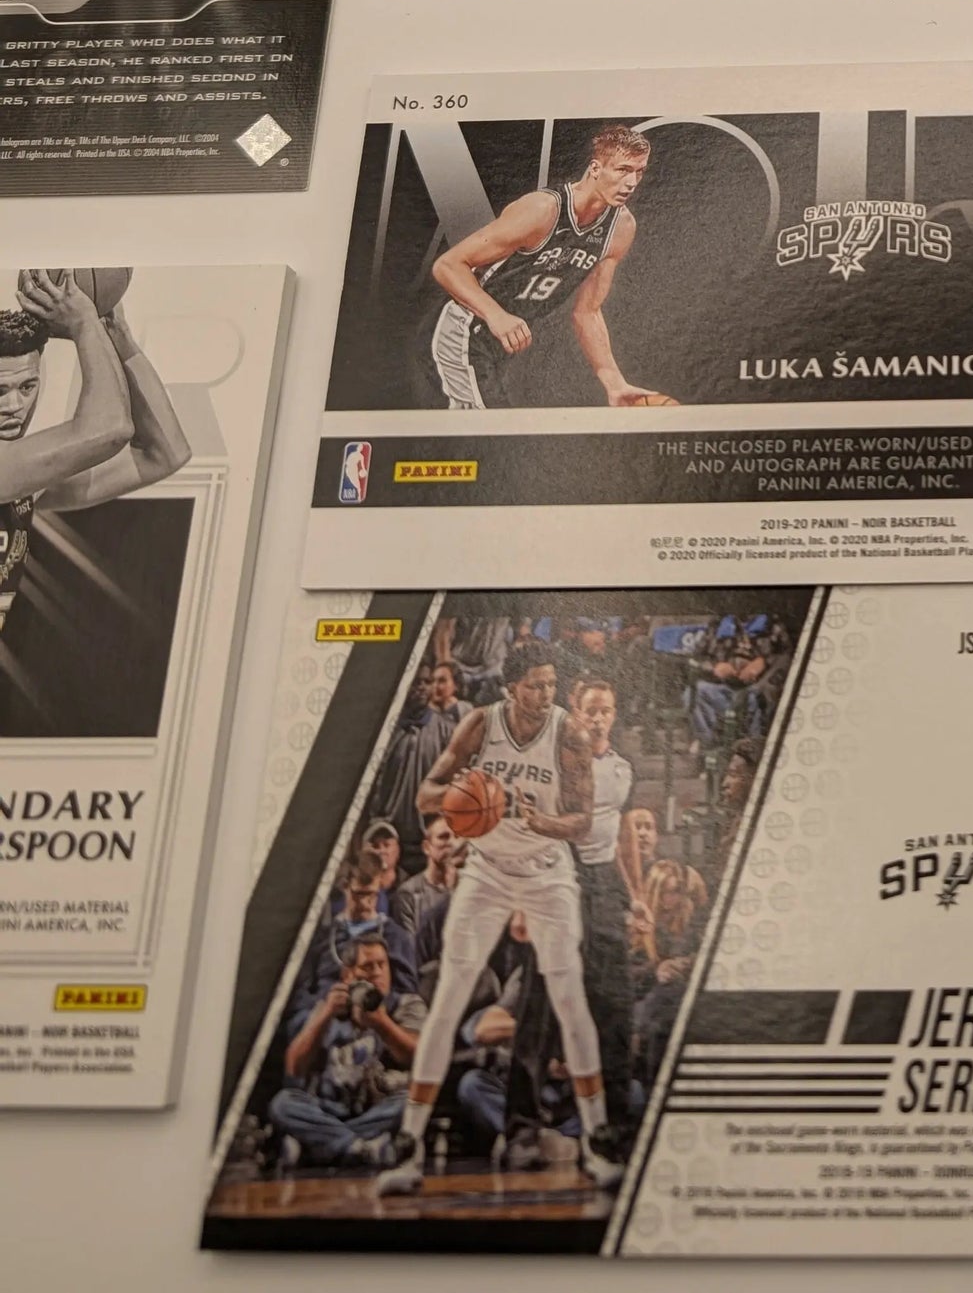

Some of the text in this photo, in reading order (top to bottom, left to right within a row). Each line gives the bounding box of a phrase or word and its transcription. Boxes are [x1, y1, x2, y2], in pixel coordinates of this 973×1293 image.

[5, 35, 286, 50] GRITTY PLAYER WHO DOES WHAT IT
[393, 94, 469, 110] No. 360
[804, 201, 927, 220] SAN ANTONIO
[776, 214, 952, 281] SPURS
[532, 247, 598, 271] SPURS
[513, 274, 563, 300] 19
[739, 357, 824, 380] LUKA
[657, 442, 688, 455] THE
[693, 440, 786, 455] ENCLOSED
[792, 436, 973, 453] PLAYER-WORN/USED
[400, 465, 473, 477] PANINI
[322, 624, 397, 637] PANINI
[483, 760, 553, 786] SPURS
[904, 835, 939, 852] SAN
[63, 900, 129, 914] MATERIAL
[61, 990, 140, 1005] PANINI
